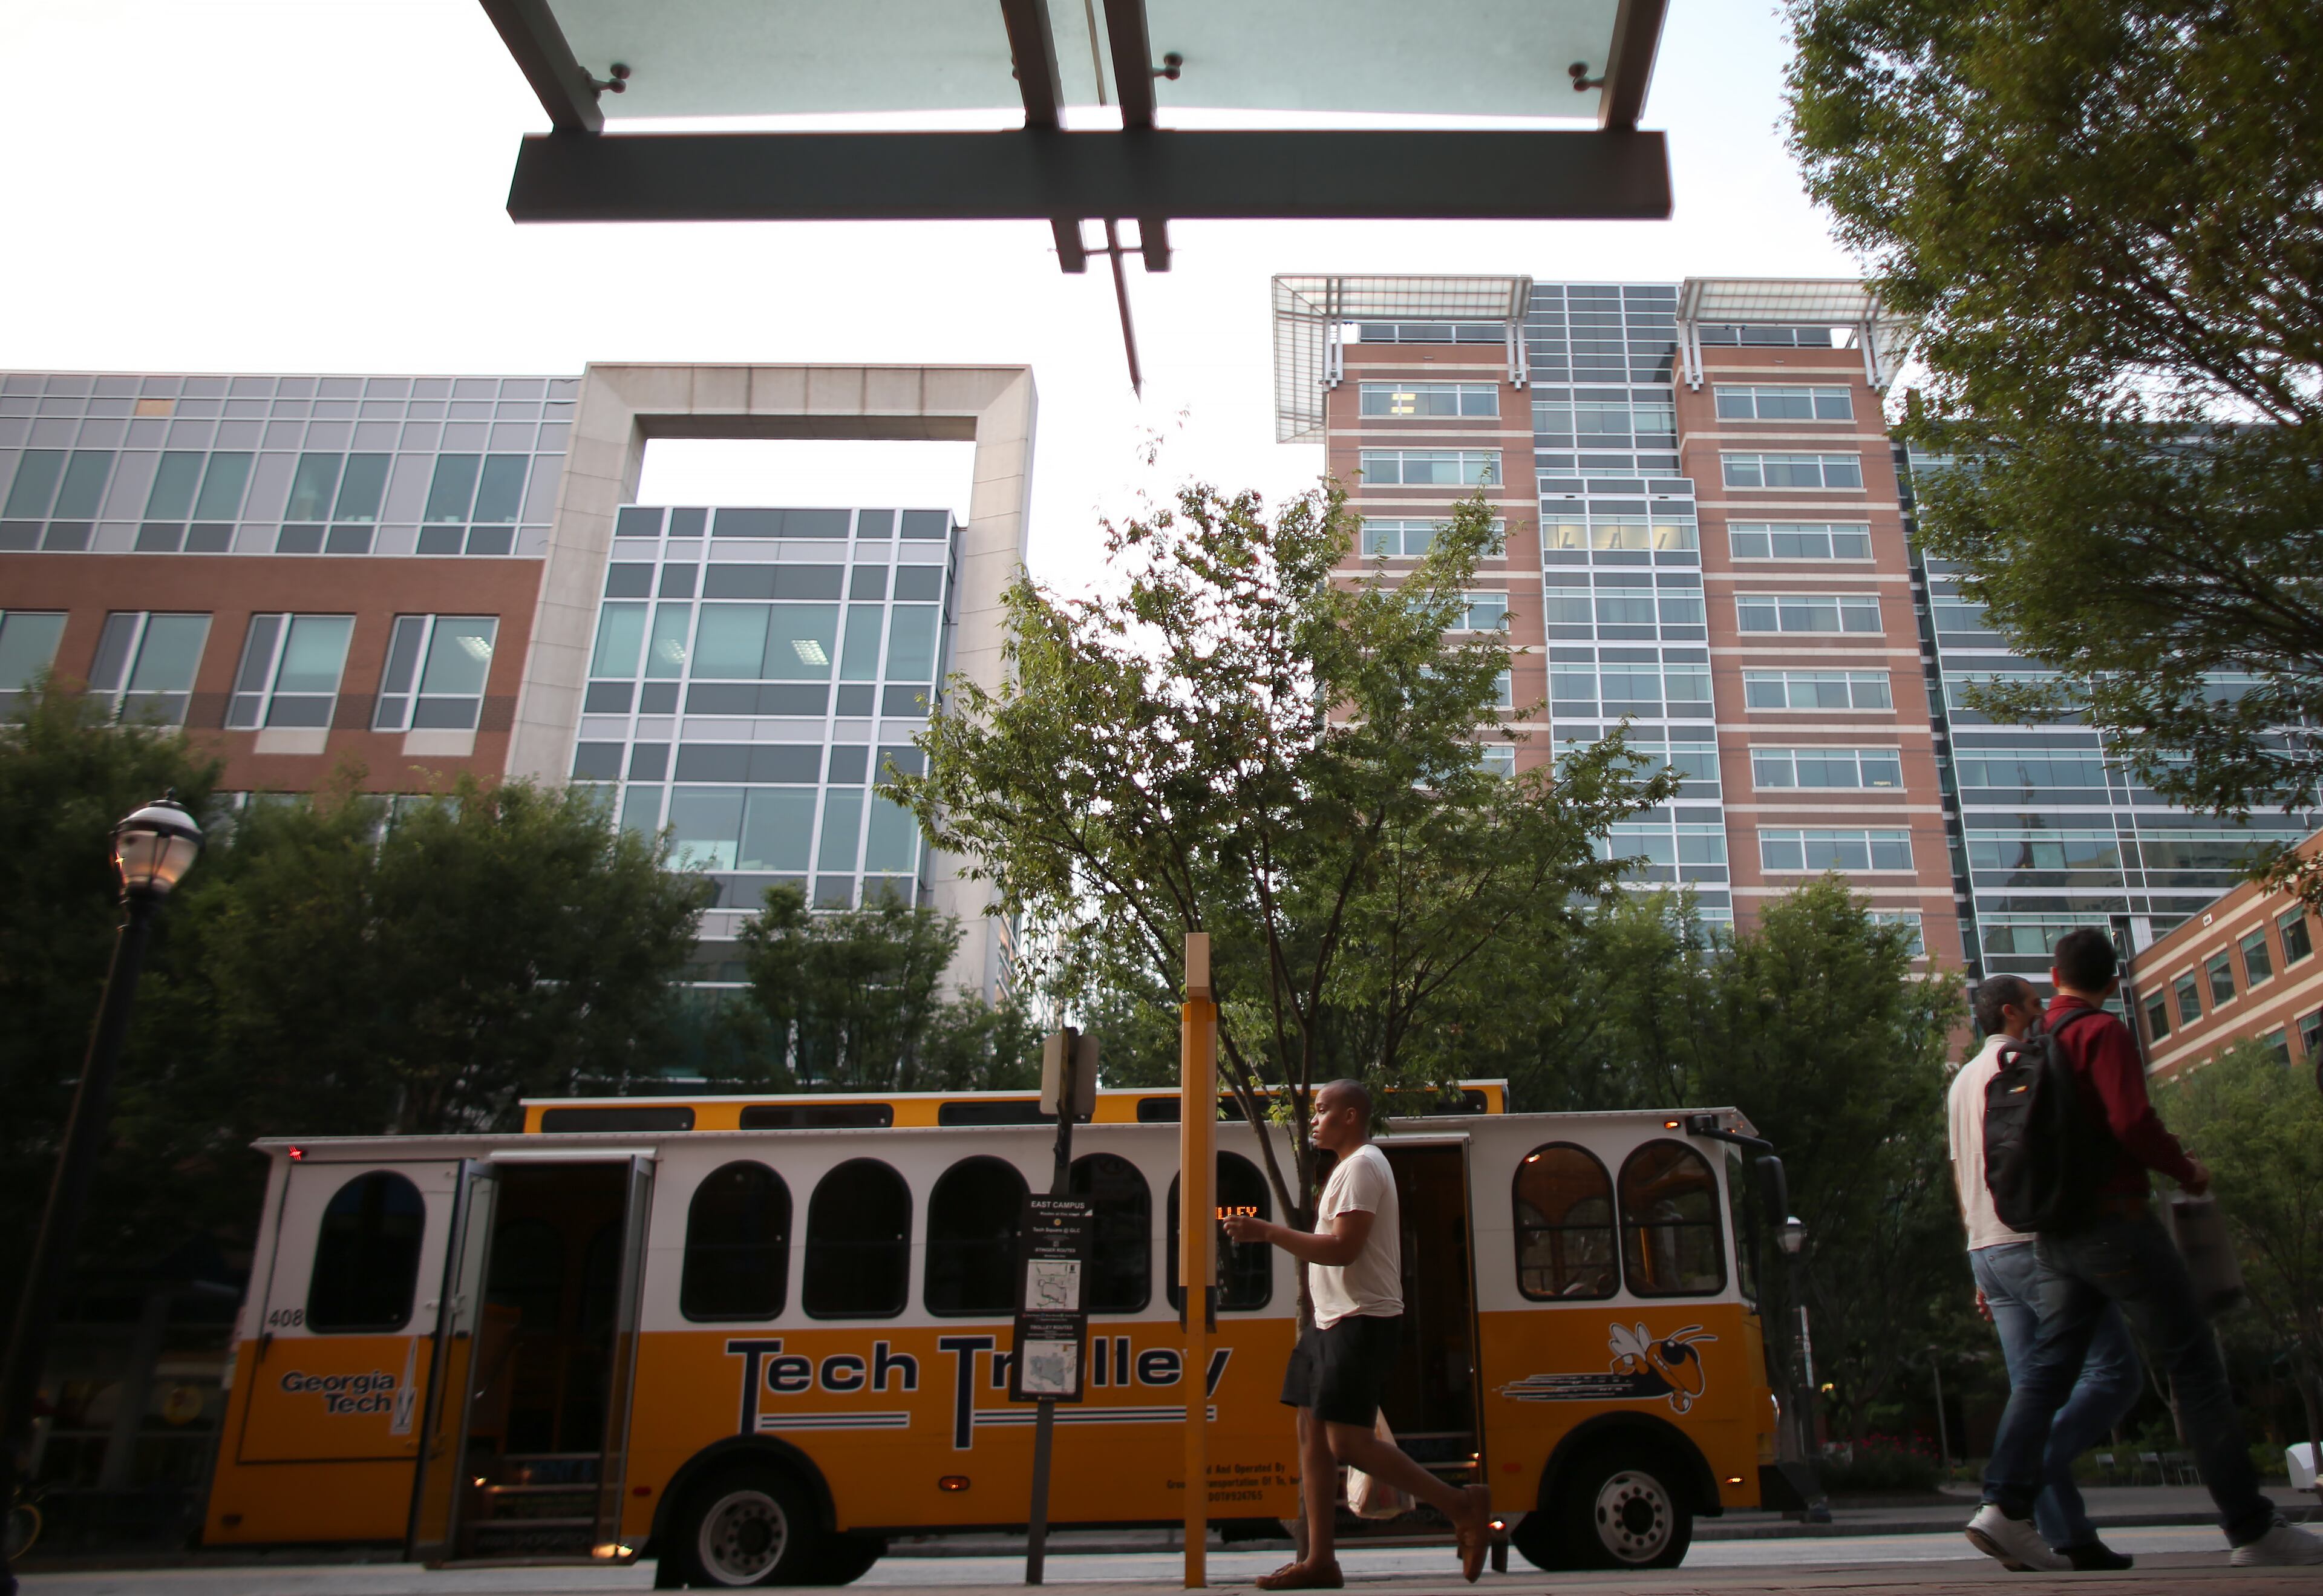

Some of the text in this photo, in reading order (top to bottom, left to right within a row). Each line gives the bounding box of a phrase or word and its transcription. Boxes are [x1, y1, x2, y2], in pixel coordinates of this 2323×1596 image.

[1053, 1201, 1085, 1209] CAMPUS
[270, 1309, 302, 1327] 408
[280, 1370, 396, 1394] Georgia
[726, 1334, 1234, 1450] Tech Trlley
[324, 1392, 393, 1413] Tech
[1206, 1477, 1259, 1489] ransportation
